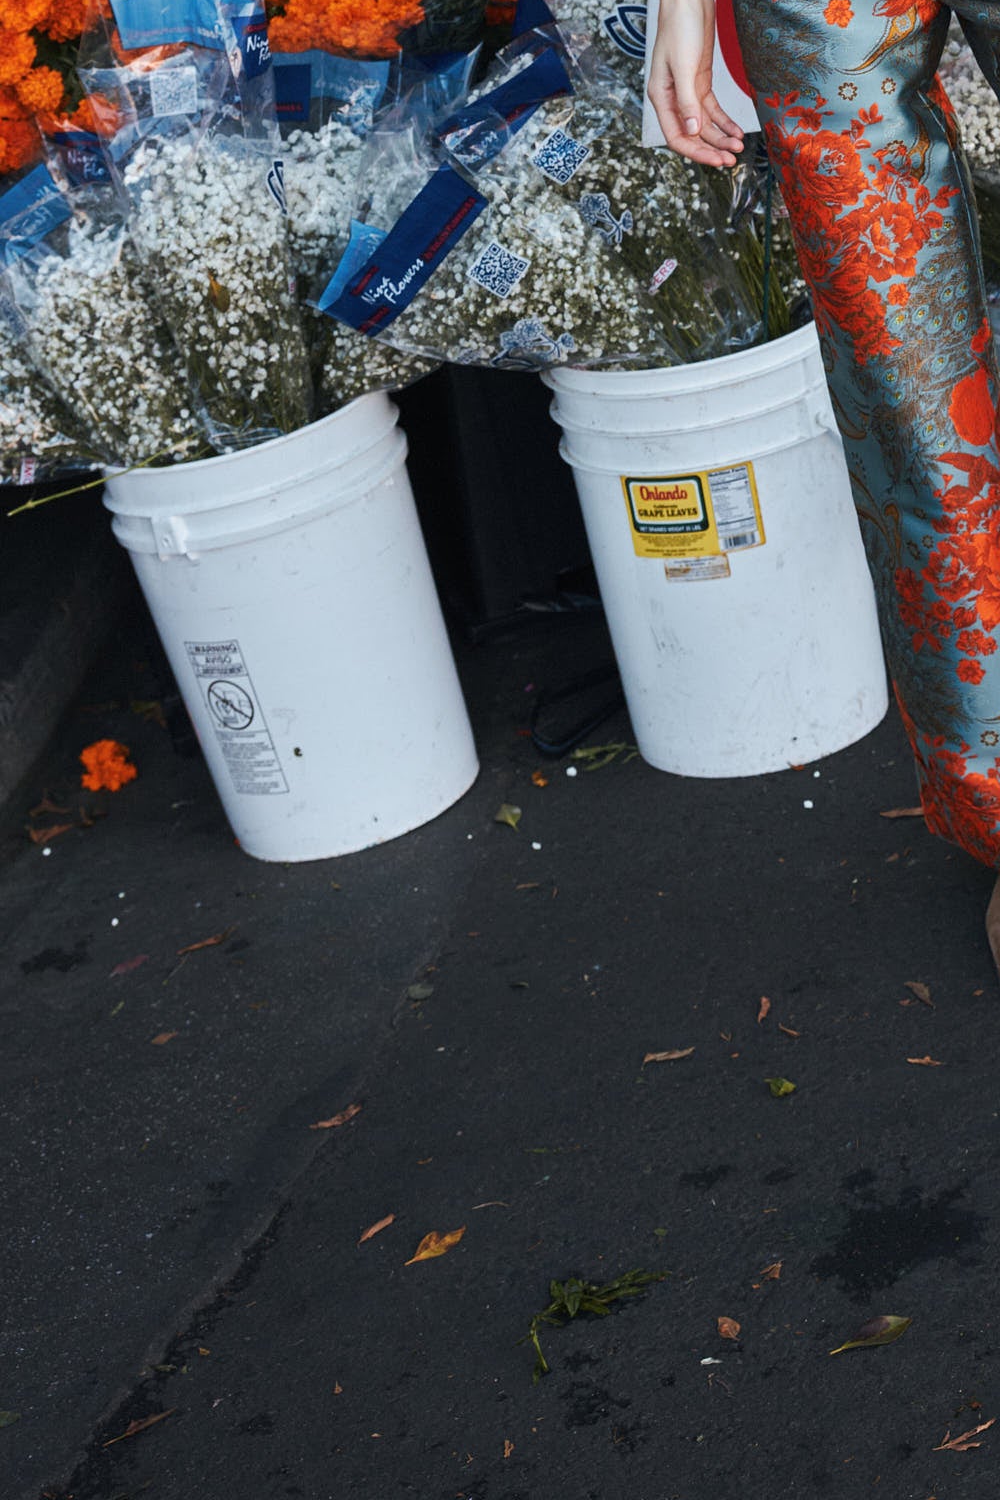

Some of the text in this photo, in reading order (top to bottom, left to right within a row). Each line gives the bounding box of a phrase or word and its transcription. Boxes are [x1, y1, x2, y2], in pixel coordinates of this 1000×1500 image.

[361, 276, 391, 304] Nina
[383, 258, 424, 304] Flowers
[640, 485, 688, 501] Orlando
[638, 507, 698, 518] GRAPE LEAVES
